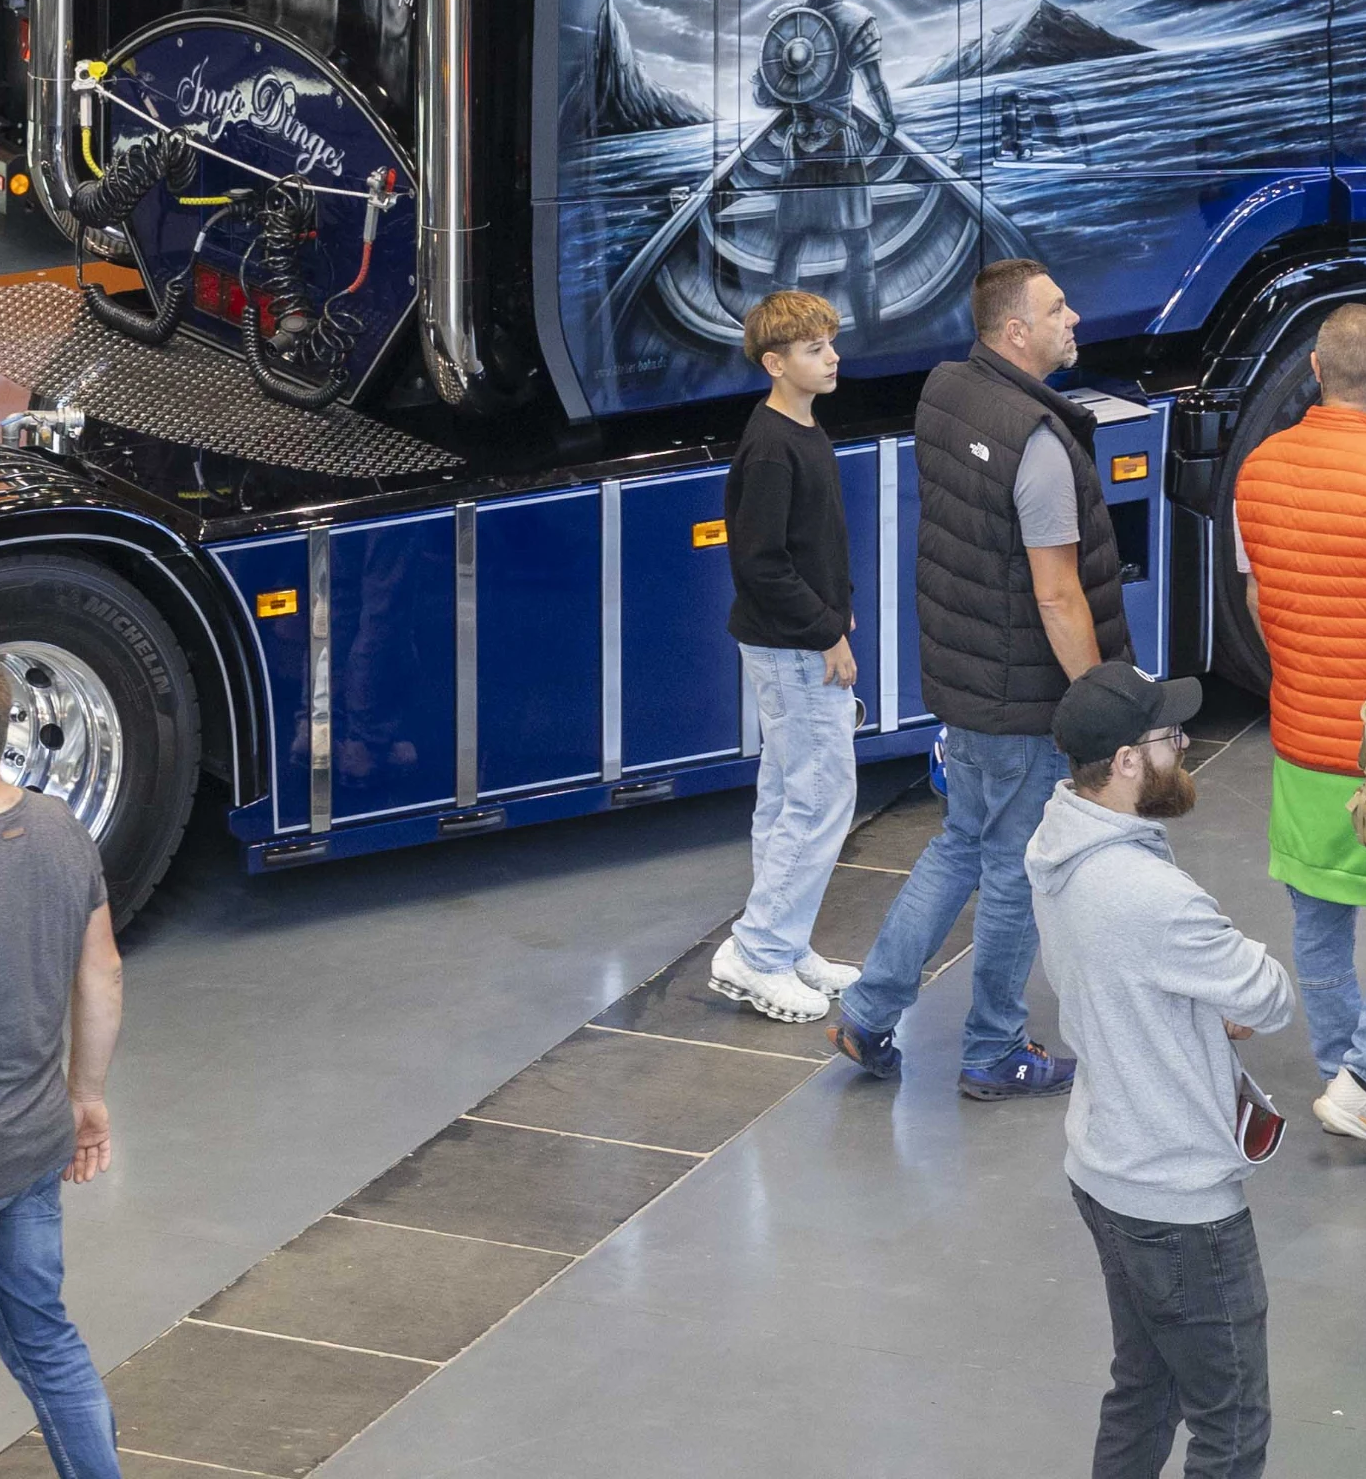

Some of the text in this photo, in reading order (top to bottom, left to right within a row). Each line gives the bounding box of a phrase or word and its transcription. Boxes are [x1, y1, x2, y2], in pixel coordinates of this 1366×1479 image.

[176, 55, 345, 177] Ingo Dinges
[84, 595, 172, 695] MICHELIN
